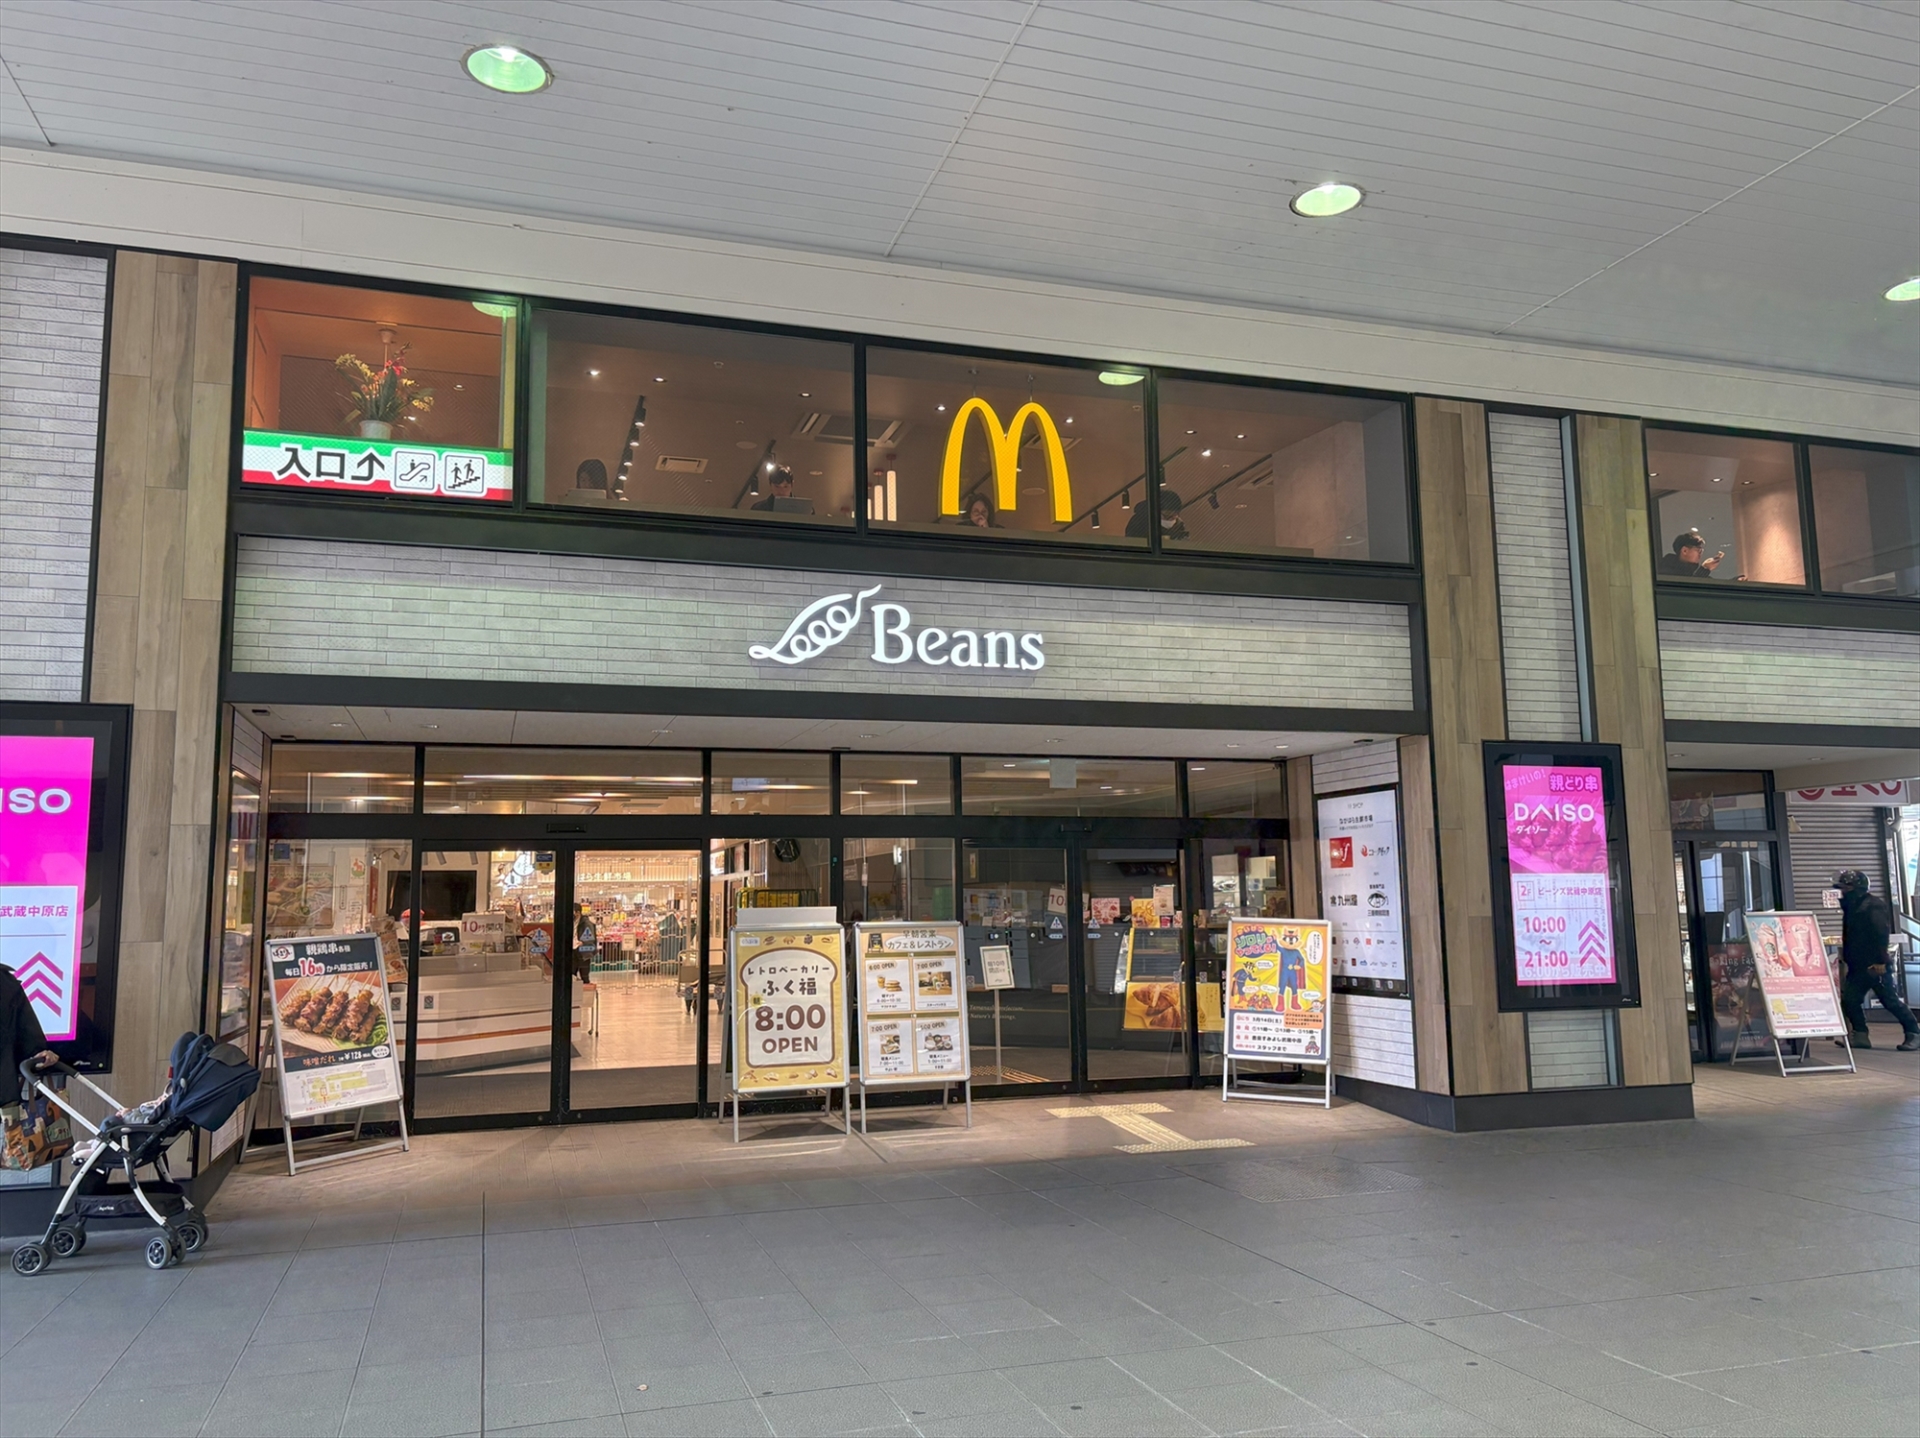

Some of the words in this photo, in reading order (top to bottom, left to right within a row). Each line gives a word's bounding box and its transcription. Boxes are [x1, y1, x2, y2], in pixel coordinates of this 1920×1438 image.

[277, 447, 346, 480] 入口
[870, 603, 1046, 671] Beans
[1549, 773, 1599, 793] 親どり串
[1513, 802, 1595, 823] DAISO
[1515, 824, 1548, 835] ダイソー
[1520, 884, 1532, 897] 2F
[1522, 916, 1567, 934] 10:00
[1524, 950, 1569, 968] 21:00
[747, 965, 830, 976] レトロベーカリー
[762, 977, 817, 996] ふく福
[755, 1003, 826, 1032] 8:00
[761, 1036, 818, 1054] OPEN
